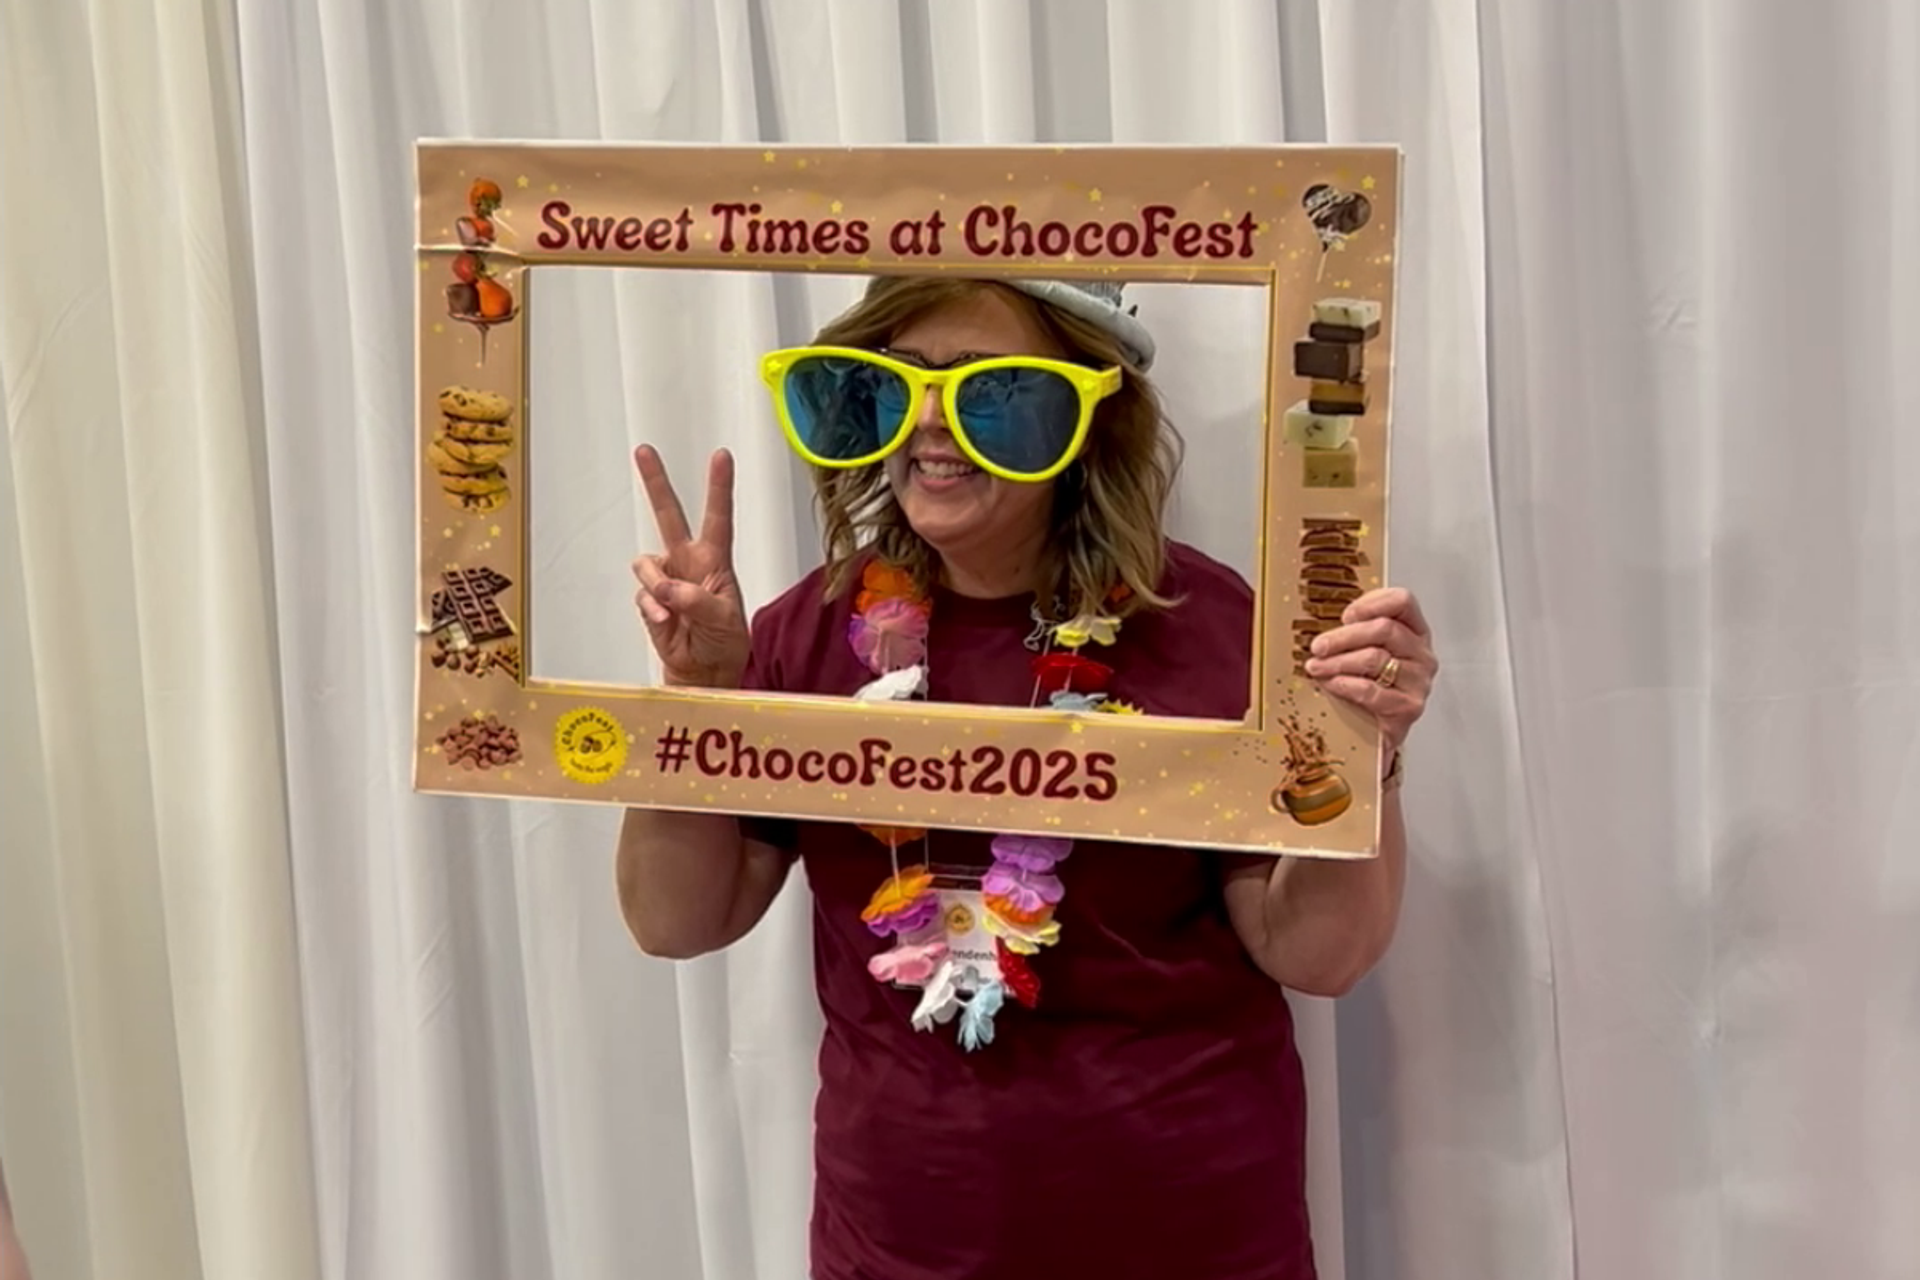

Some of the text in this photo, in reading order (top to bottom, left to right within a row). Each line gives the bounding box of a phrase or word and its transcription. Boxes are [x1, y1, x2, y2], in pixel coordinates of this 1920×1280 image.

[538, 200, 1259, 260] Sweet Times at ChocoFest
[655, 725, 1118, 802] #ChocoFest2025
